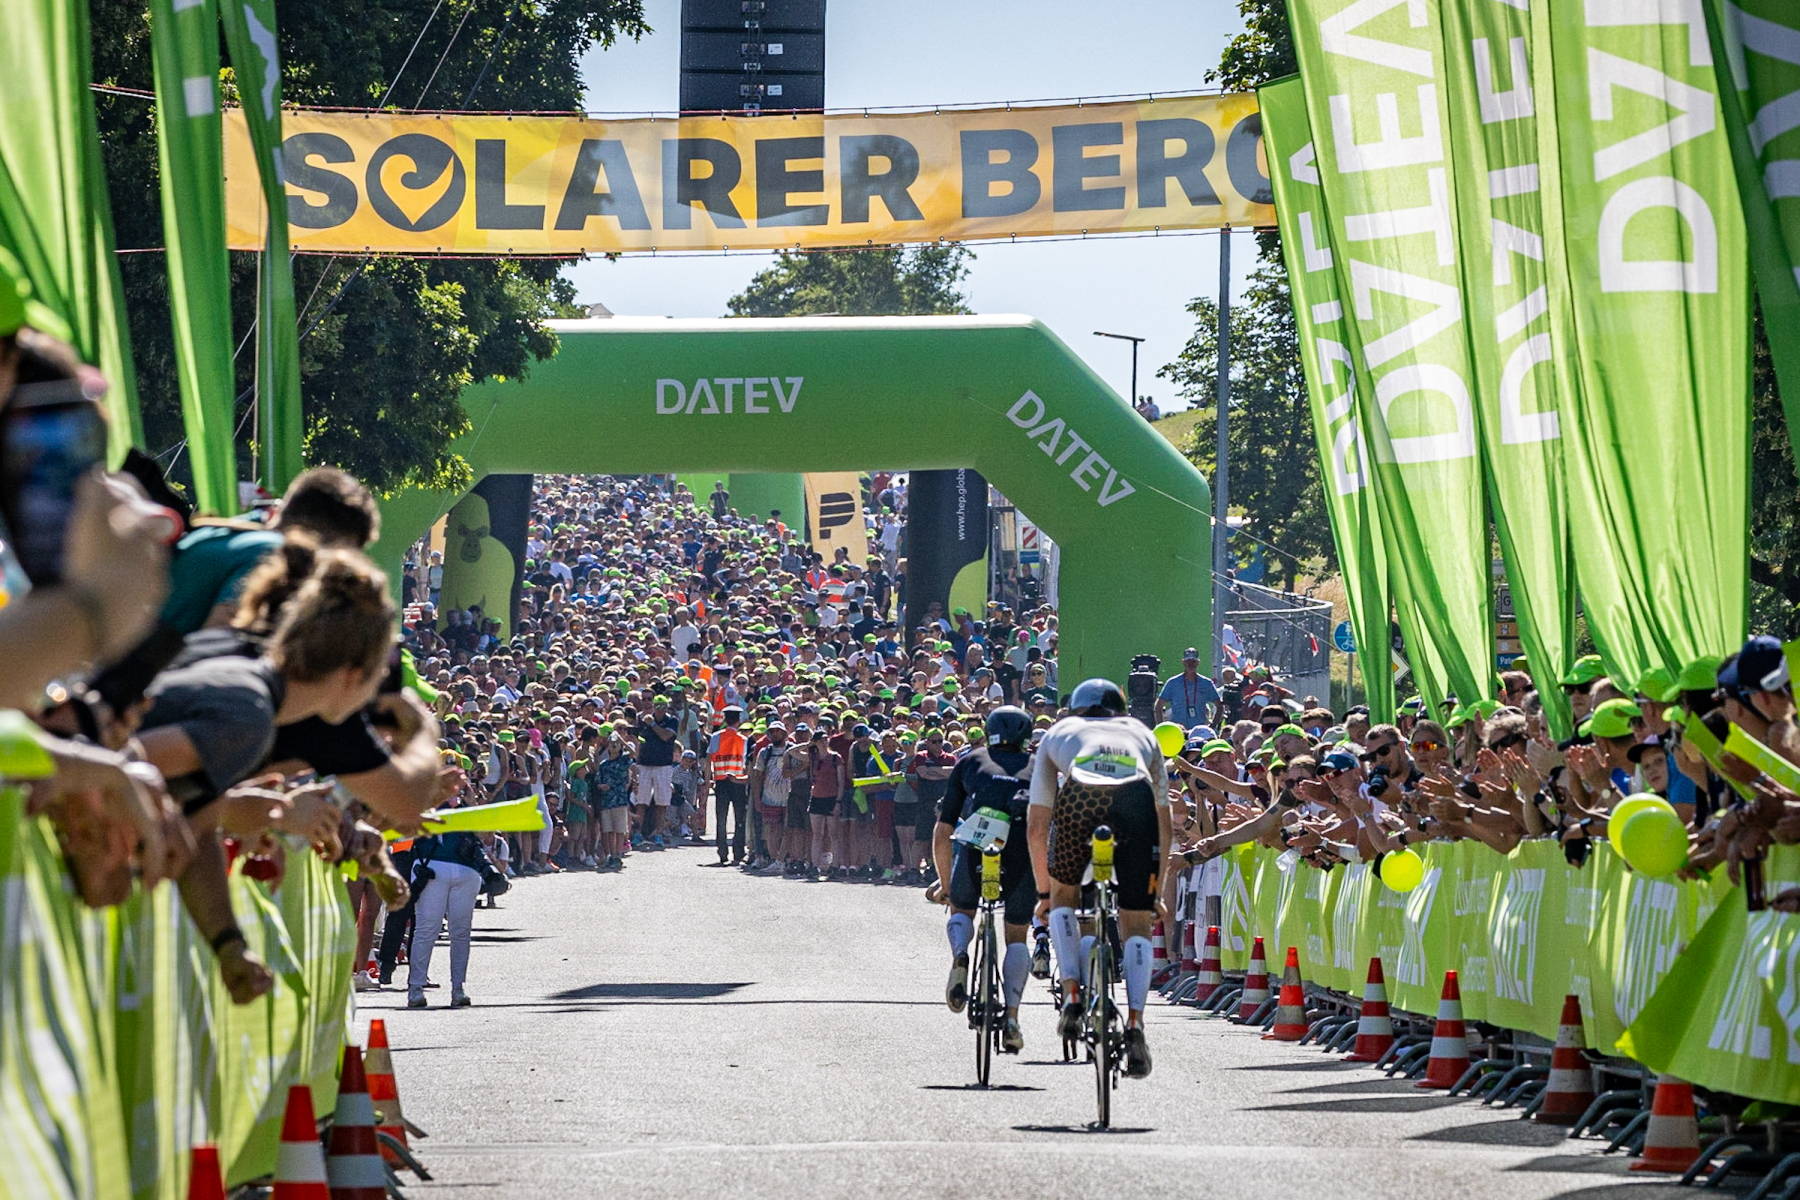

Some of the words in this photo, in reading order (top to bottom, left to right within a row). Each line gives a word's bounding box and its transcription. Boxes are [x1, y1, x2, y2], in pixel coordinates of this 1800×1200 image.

[283, 132, 925, 231] SOLARER
[655, 376, 804, 414] DATEV
[1005, 389, 1136, 508] DATEV
